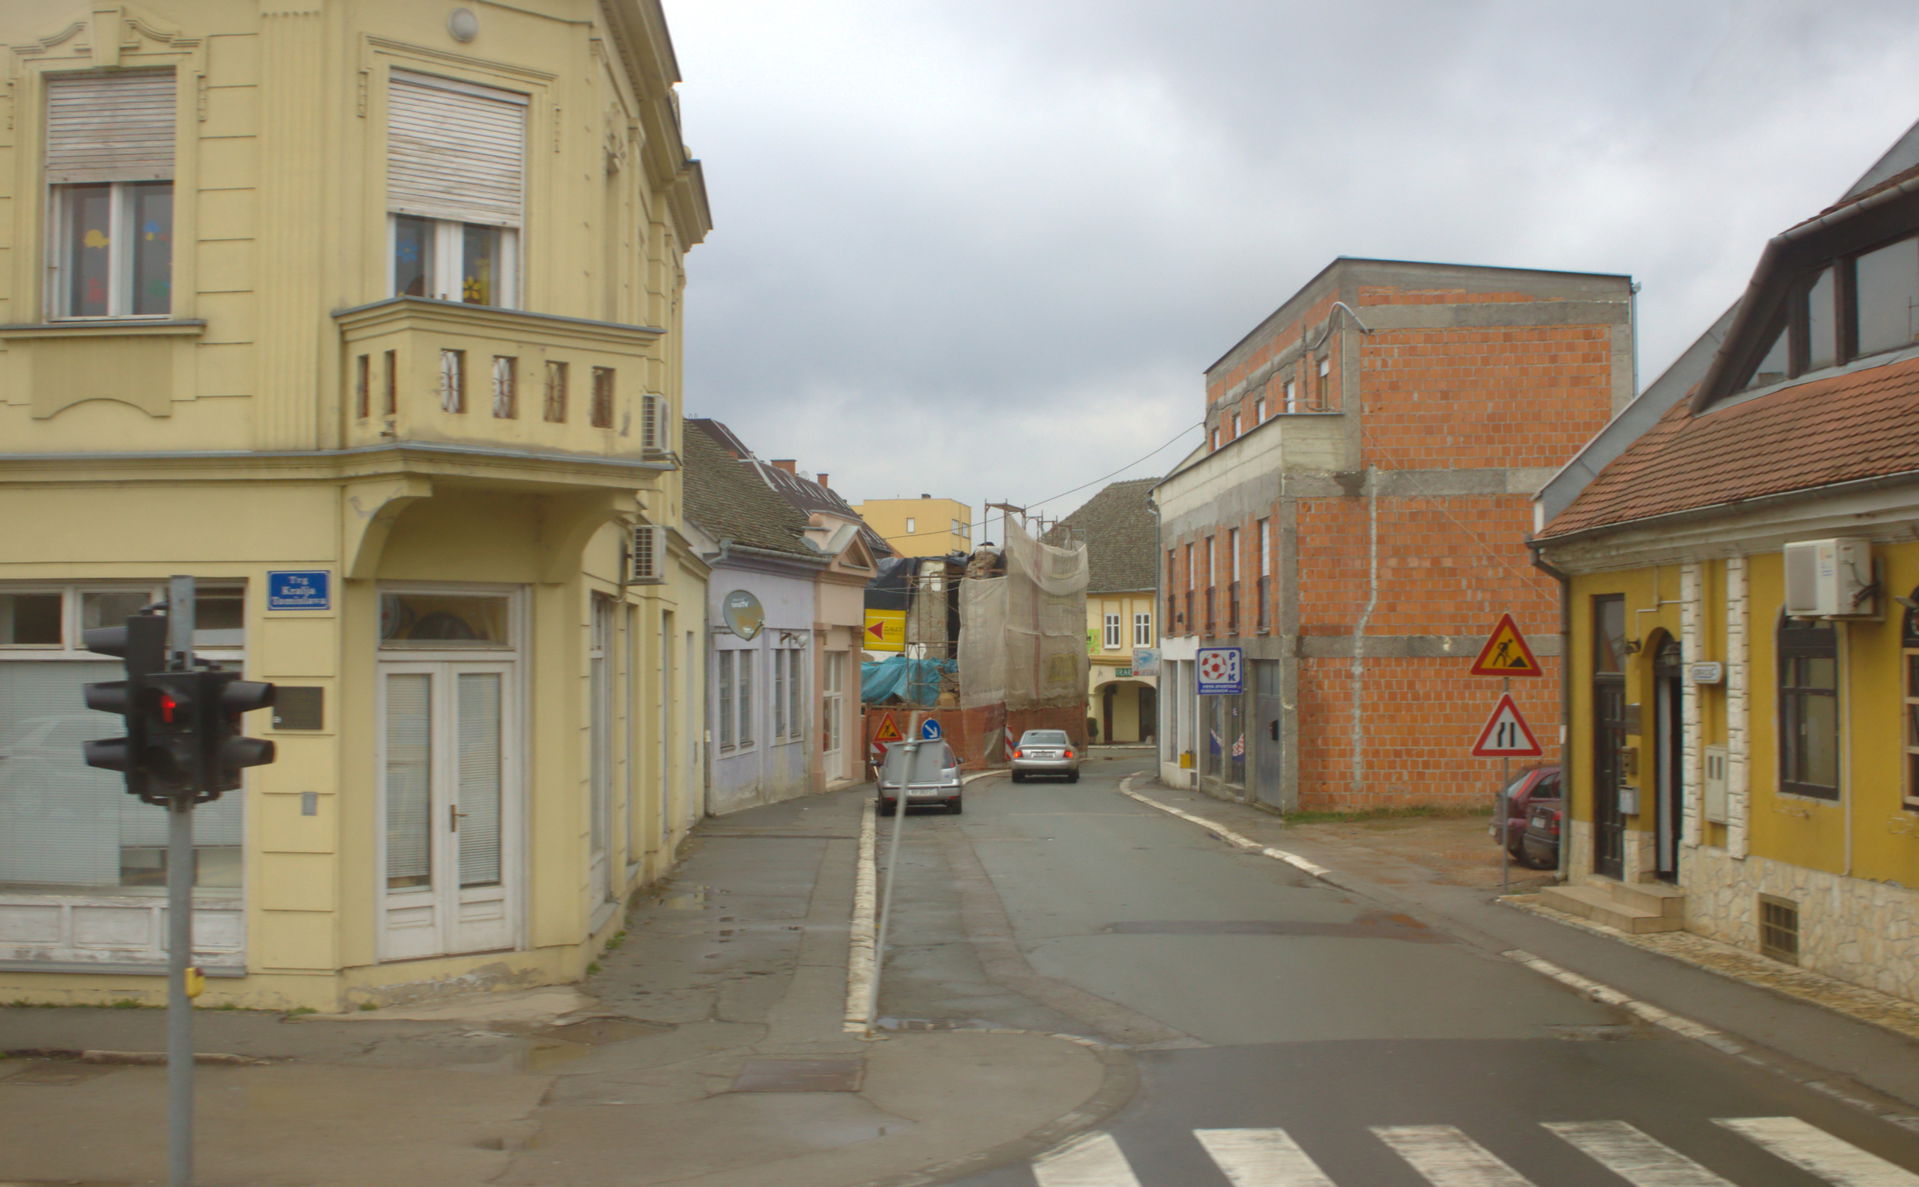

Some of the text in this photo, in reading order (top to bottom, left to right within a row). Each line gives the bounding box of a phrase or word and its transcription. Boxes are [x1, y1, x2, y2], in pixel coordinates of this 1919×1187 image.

[288, 576, 309, 585] Trg
[281, 586, 316, 597] Kralja
[271, 596, 327, 605] Tomislava
[1228, 651, 1236, 682] PSK
